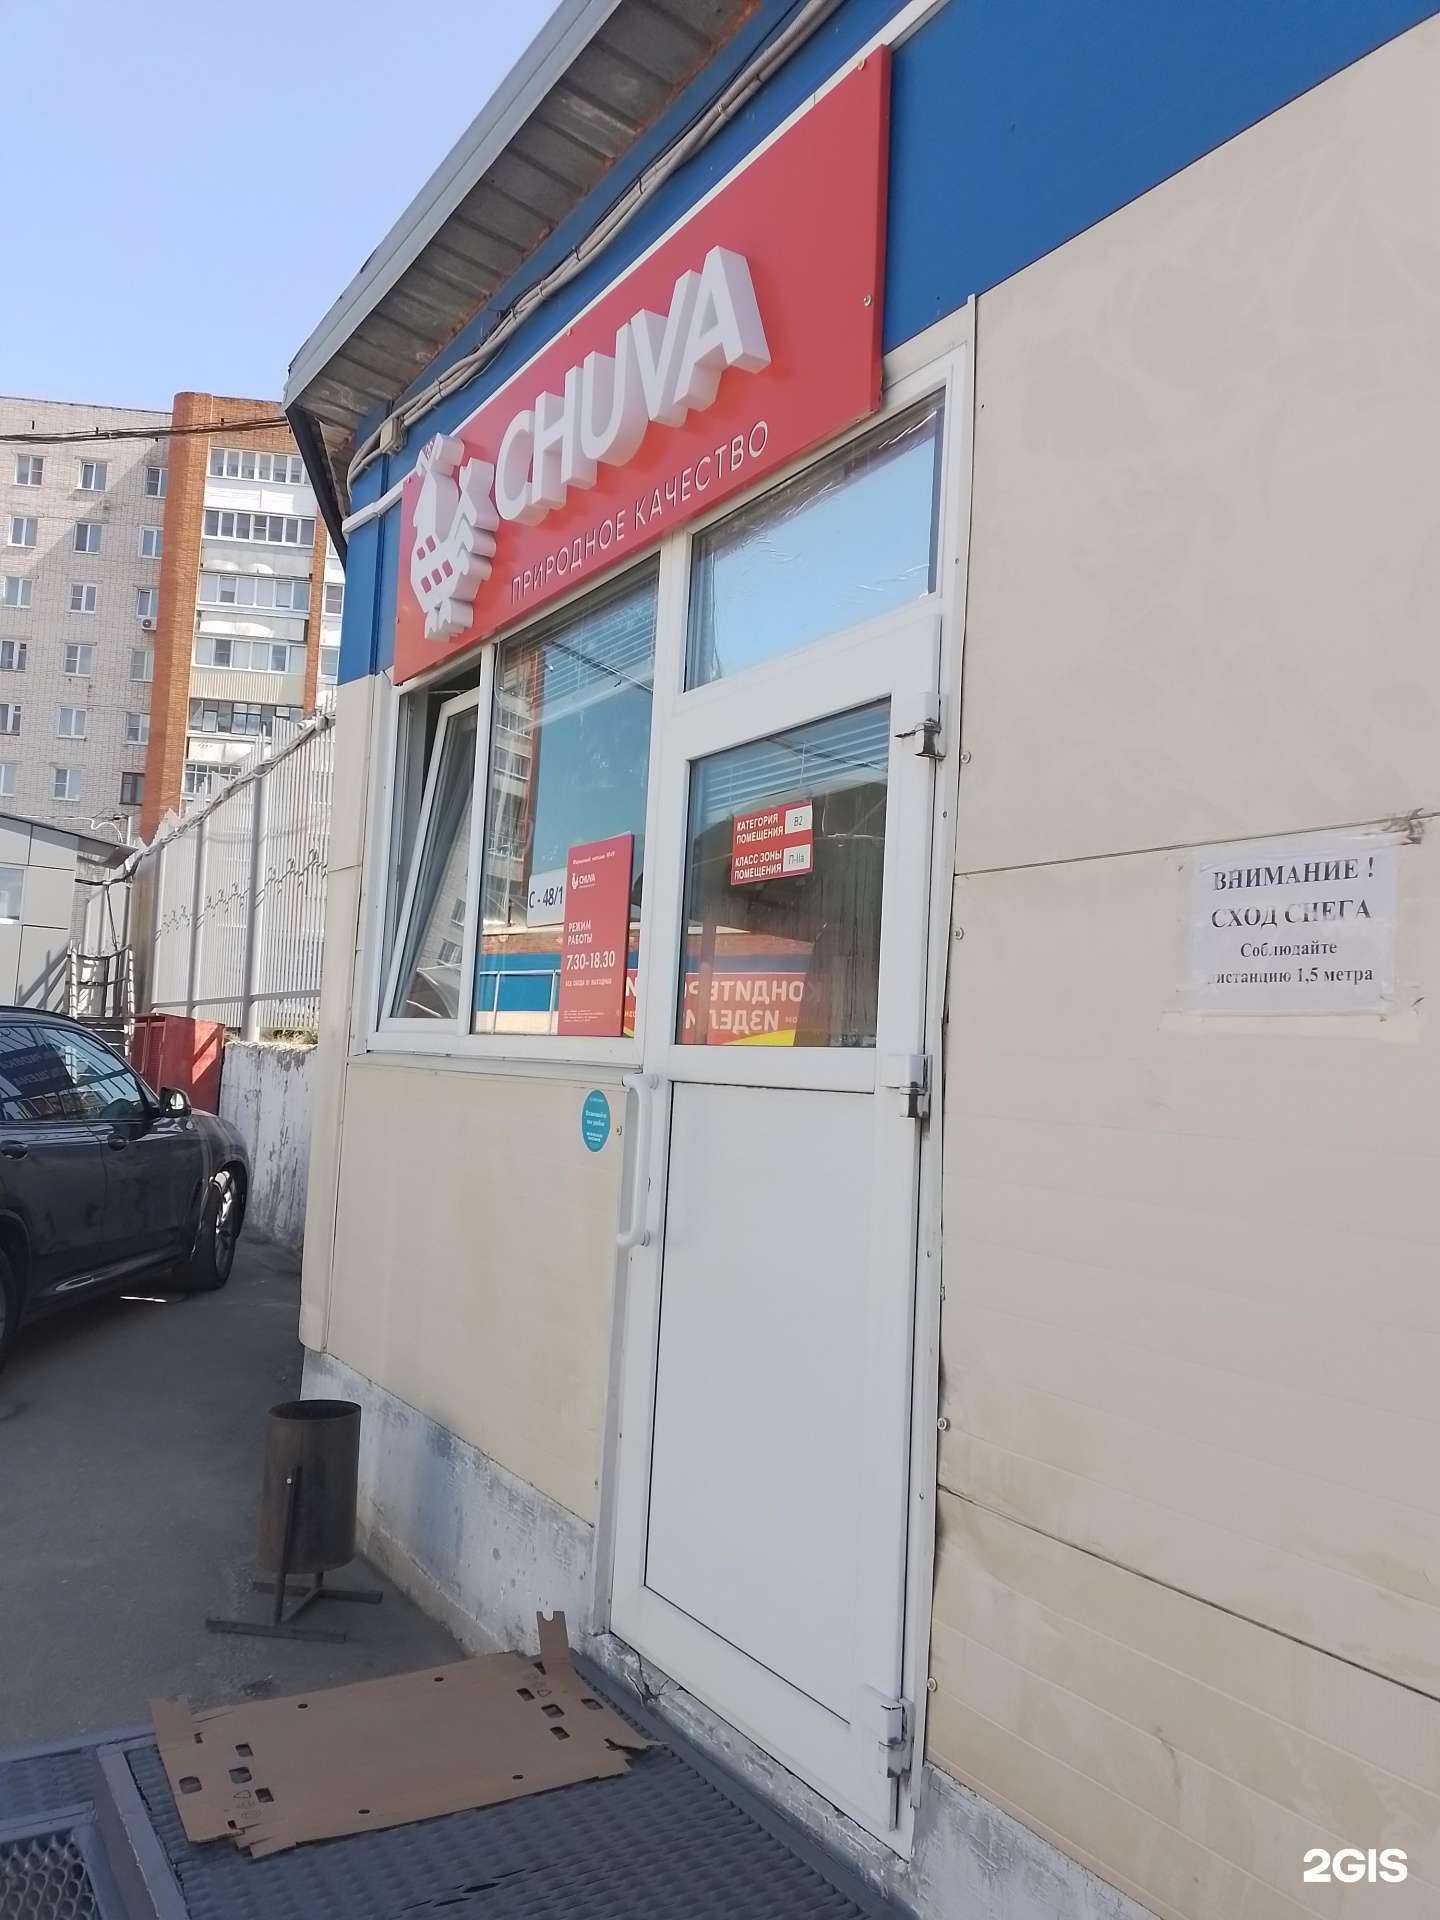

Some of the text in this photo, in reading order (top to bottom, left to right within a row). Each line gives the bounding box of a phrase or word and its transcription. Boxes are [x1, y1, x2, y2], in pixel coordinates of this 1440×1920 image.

[495, 245, 771, 525] CHUVA
[511, 421, 768, 604] ПРИРОДНОЕ КАЧЕСТВО
[736, 813, 778, 831] КАТЕГОРИЯ
[736, 826, 783, 845] ПОМЕЩЕНИЯ
[735, 853, 759, 868] КЛАСС
[759, 850, 782, 863] ЗОНЫ
[734, 863, 782, 880] ПОМЕЩЕНИЯ
[1213, 858, 1360, 890] ВНИМАНИЕ
[1211, 899, 1372, 928] СХОД СНЕГА
[568, 920, 592, 932] РЕЖИМ
[567, 933, 593, 946] РАБОТЫ
[1240, 939, 1337, 958] Соблюдайте
[566, 950, 616, 970] 7.30-18.30
[1209, 967, 1373, 985] истанцию 1,5 метра
